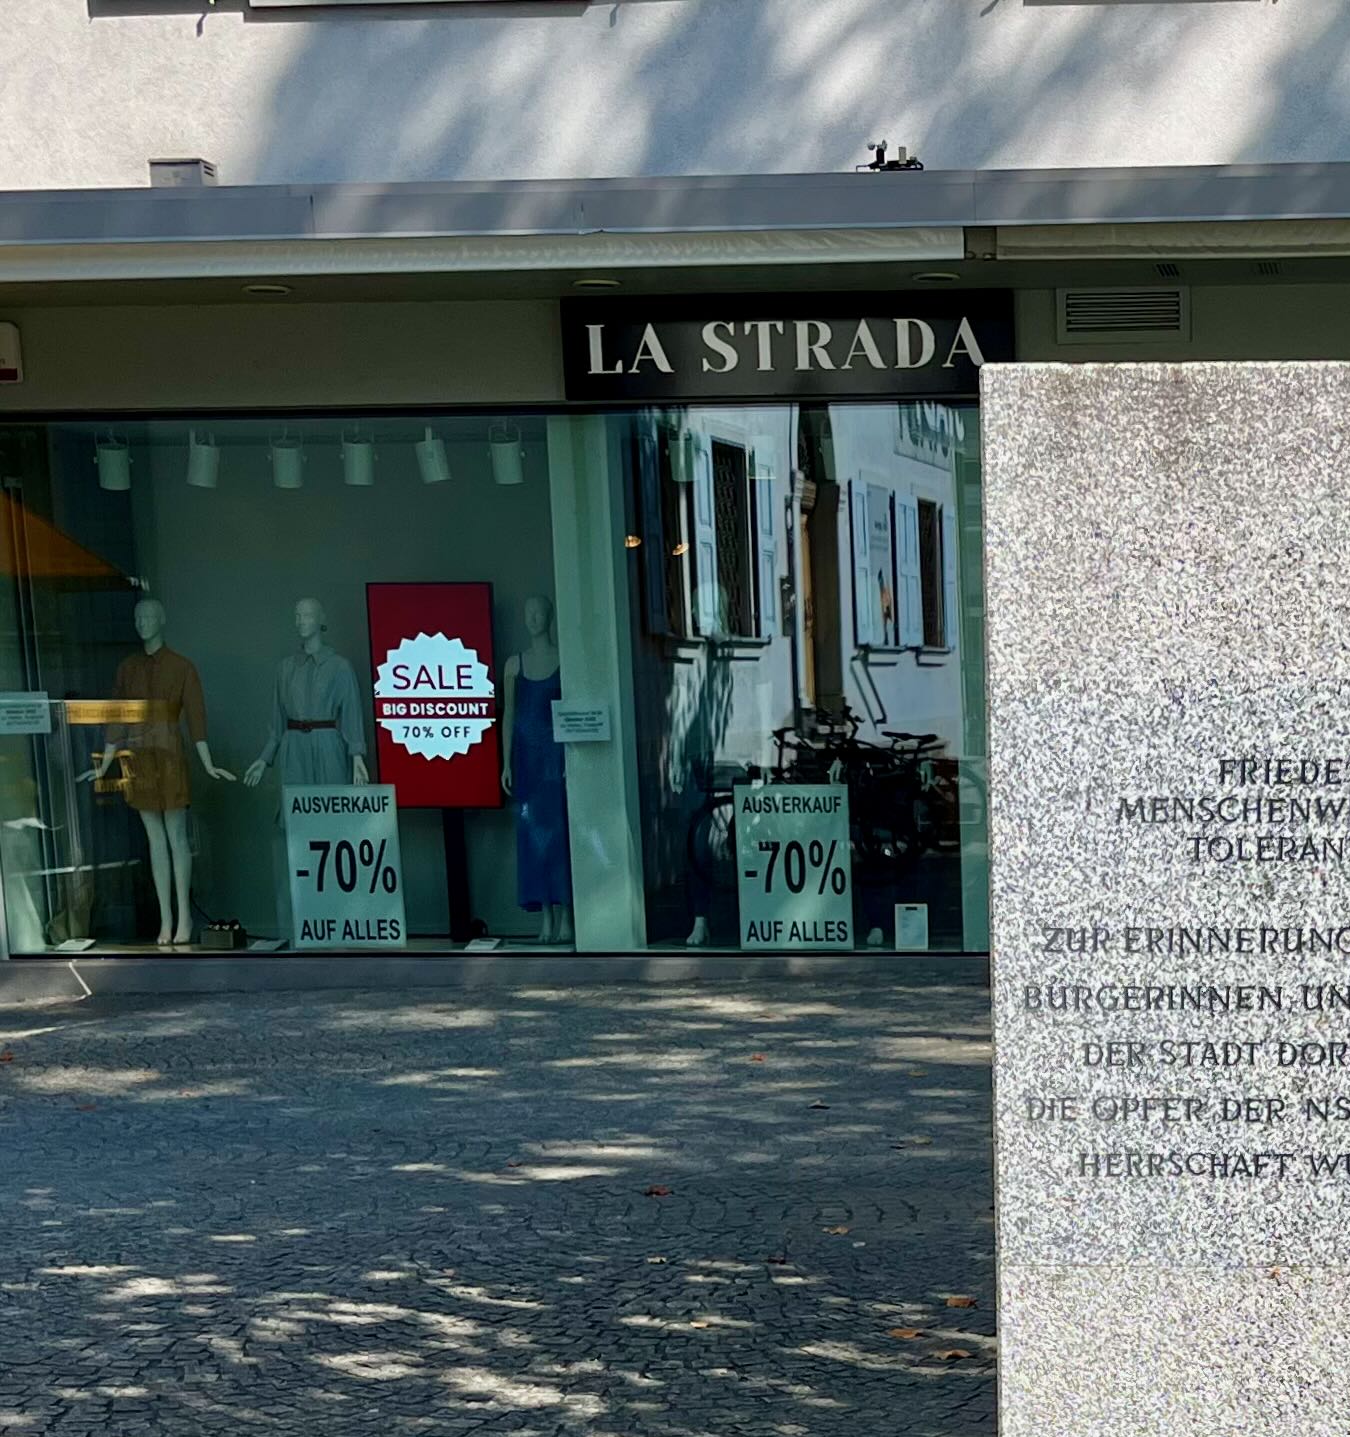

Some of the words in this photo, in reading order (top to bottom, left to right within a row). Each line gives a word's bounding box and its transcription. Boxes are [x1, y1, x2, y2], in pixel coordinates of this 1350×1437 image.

[584, 322, 675, 374] LA
[701, 317, 985, 373] STRADA
[392, 664, 474, 690] SALE
[382, 703, 407, 716] BIG
[409, 703, 489, 716] DISCOUNT
[402, 725, 434, 738] 70%
[440, 725, 472, 738] OFF
[1218, 757, 1343, 786] FRIEDE
[291, 795, 389, 814] AUSVERKAUF
[742, 795, 842, 814] AUSVERKAUF
[296, 838, 398, 894] -70%
[745, 839, 846, 895] -70%
[301, 919, 336, 941] AUF
[342, 918, 401, 941] ALLES
[746, 920, 784, 942] AUF
[788, 920, 848, 942] ALLES
[1042, 927, 1110, 953] ZUR
[1082, 1041, 1145, 1067] DER
[1158, 1039, 1262, 1067] STADT
[1026, 1097, 1077, 1122] DIE
[1091, 1096, 1203, 1123] OPFER
[1221, 1098, 1286, 1124] DER
[1079, 1152, 1294, 1179] HERRSCHAFT
